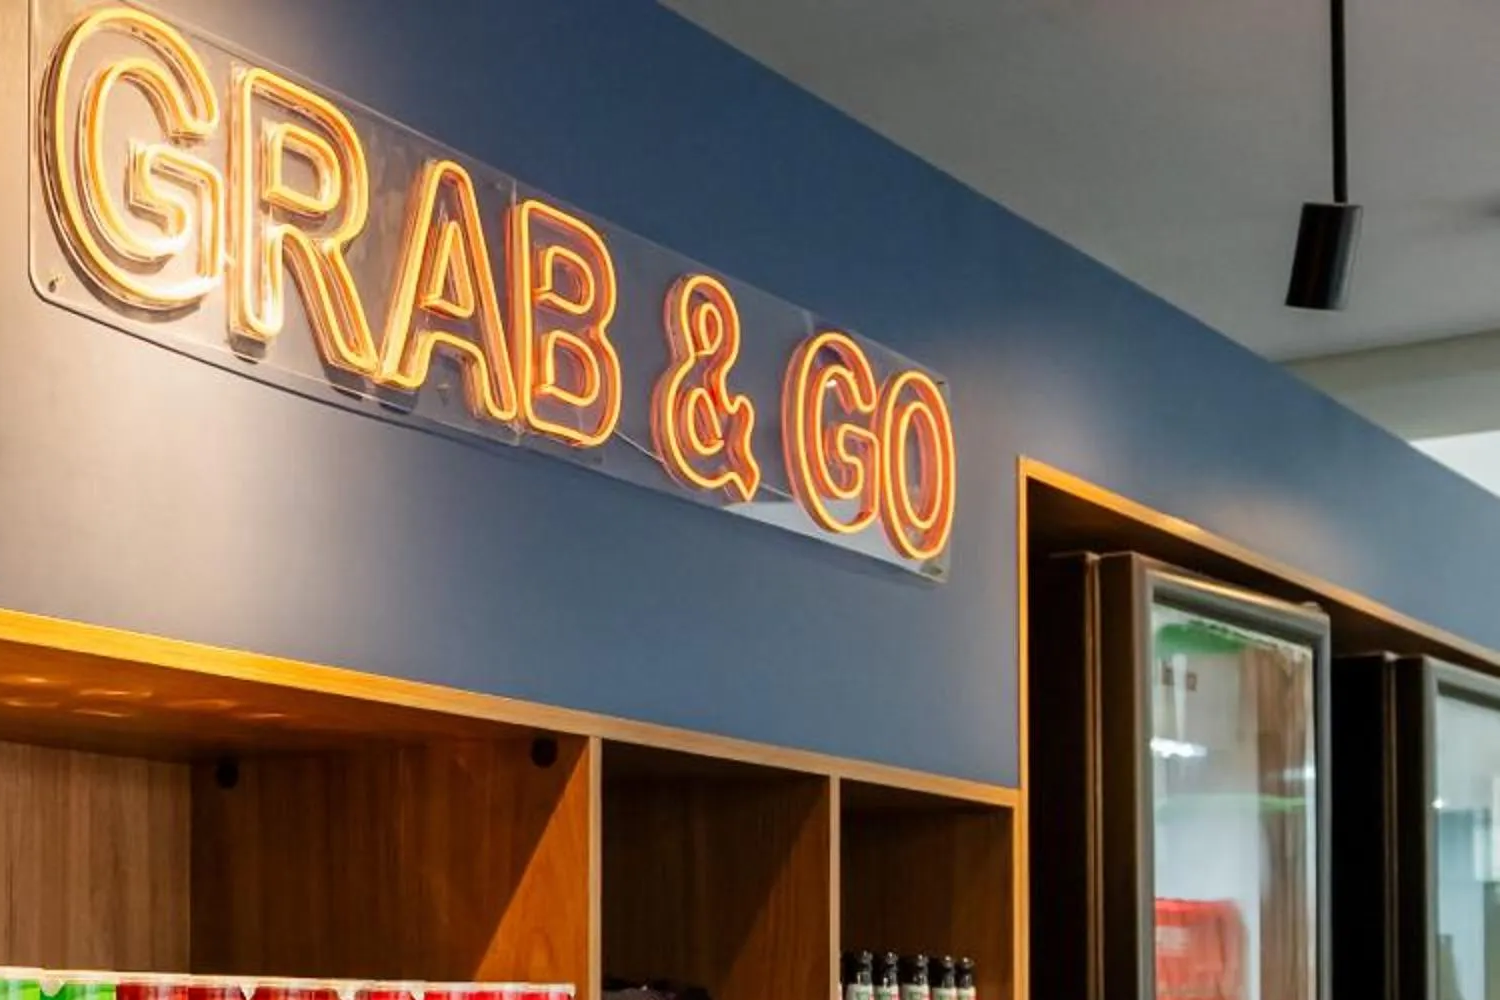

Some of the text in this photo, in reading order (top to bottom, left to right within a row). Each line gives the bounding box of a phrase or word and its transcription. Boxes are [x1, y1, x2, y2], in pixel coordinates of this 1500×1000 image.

[42, 5, 955, 560] GRAB & GO
